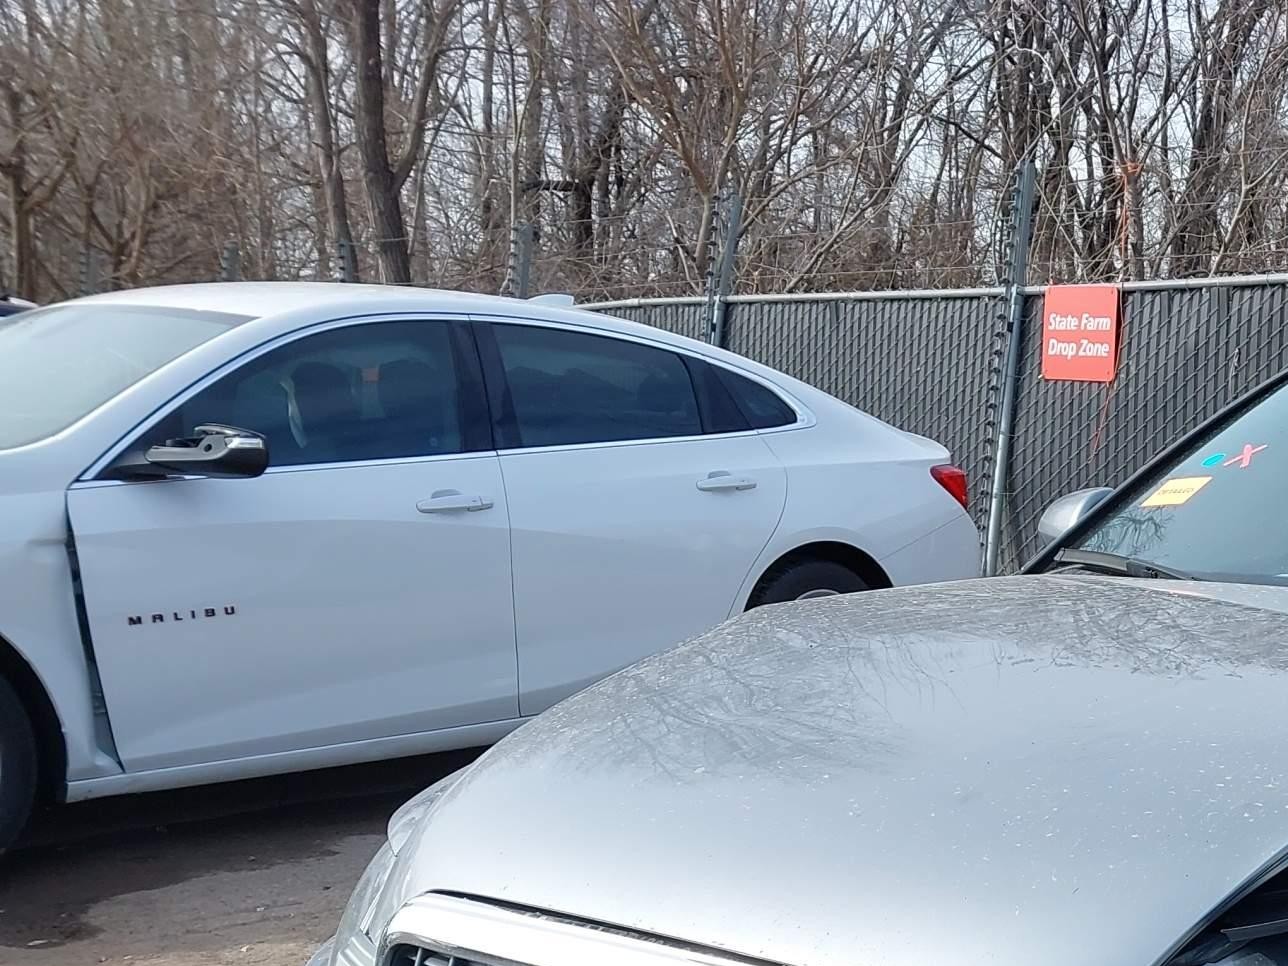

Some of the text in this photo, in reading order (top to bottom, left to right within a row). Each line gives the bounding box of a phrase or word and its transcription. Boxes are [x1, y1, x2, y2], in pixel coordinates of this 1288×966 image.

[1048, 313, 1111, 331] State Farm
[1047, 338, 1110, 360] Drop Zone
[128, 606, 236, 626] MALIBU
